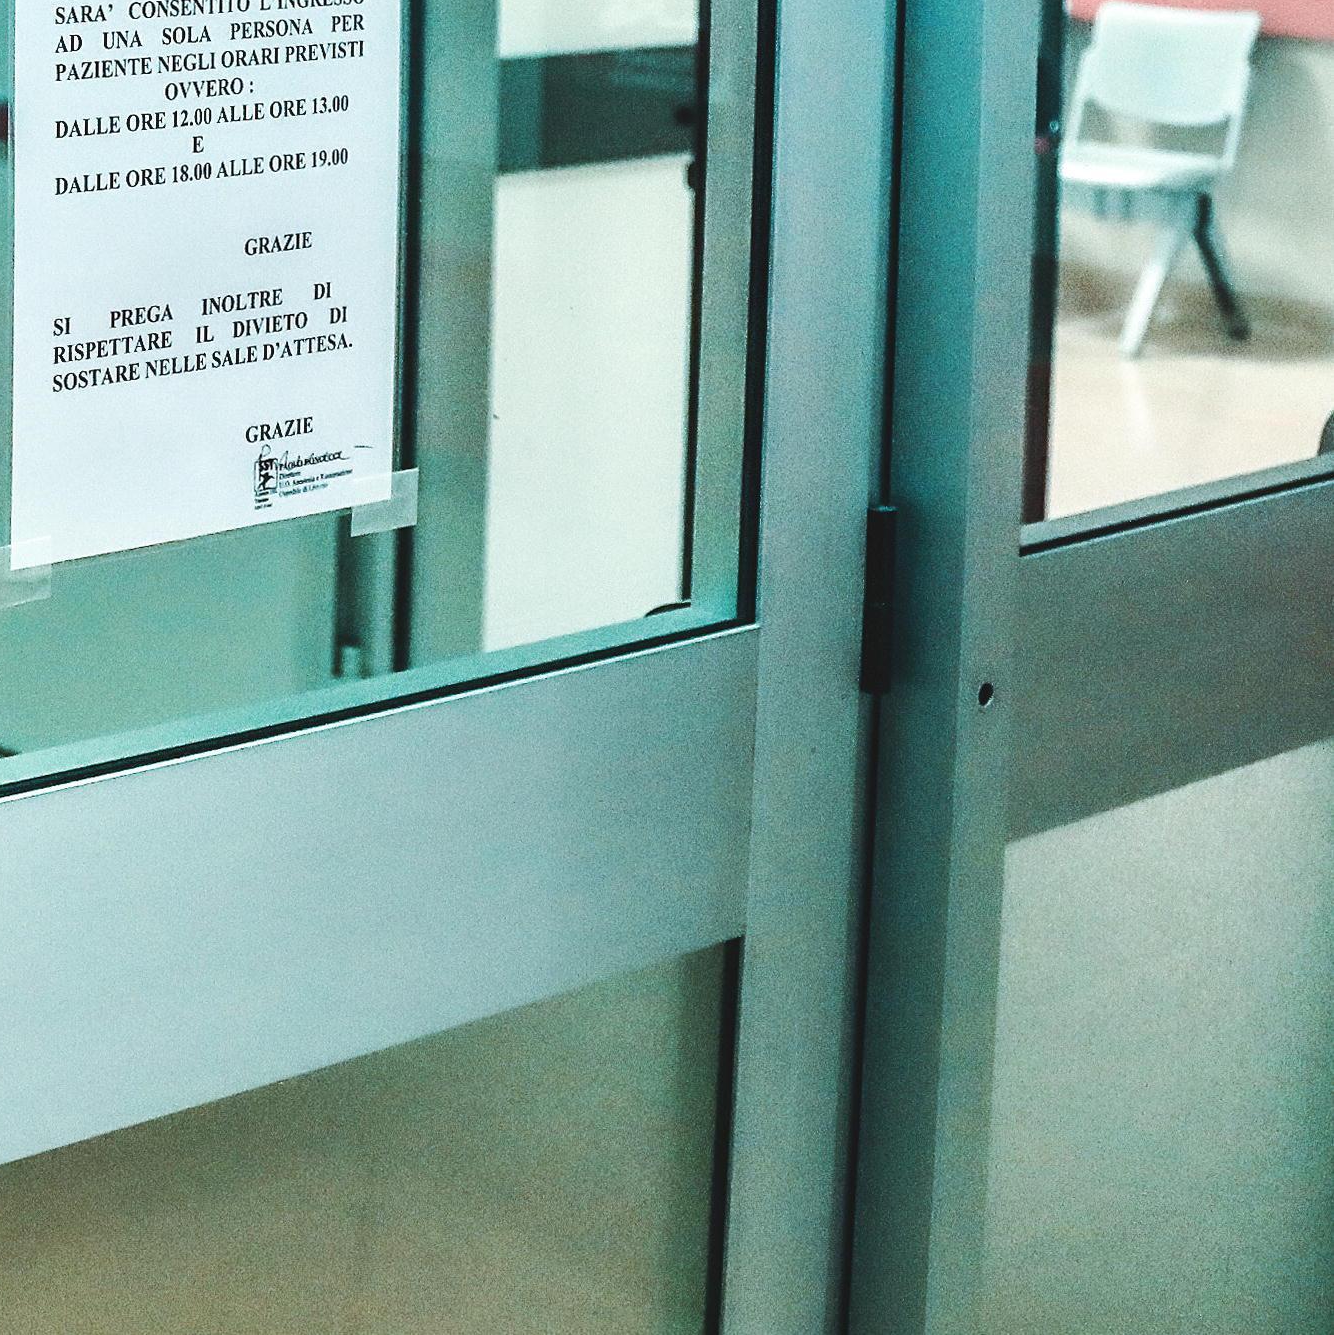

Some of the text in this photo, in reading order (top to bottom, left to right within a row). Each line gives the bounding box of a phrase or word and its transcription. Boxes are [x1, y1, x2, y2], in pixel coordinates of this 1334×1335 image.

[54, 3, 114, 25] SARA'
[54, 13, 365, 54] AD UNA SOLA PERSONA PER
[55, 40, 364, 82] PAZIENTE NEGLI ORARI PREVISTI
[55, 94, 349, 139] DALLE ORE 12.00 ALLE ORE 13.00
[192, 135, 205, 154] E
[54, 147, 349, 196] DALLE ORE 18.00 ALLE ORE 19.00
[244, 231, 313, 256] GRAZIE
[52, 281, 332, 337] SI PREGA INOLTRE DI
[53, 305, 348, 365] RISPETTARE IL DIVIETO DI
[52, 332, 353, 393] SOSTARE NELLE SALE D'ATTESA.
[245, 416, 314, 444] GRAZIE
